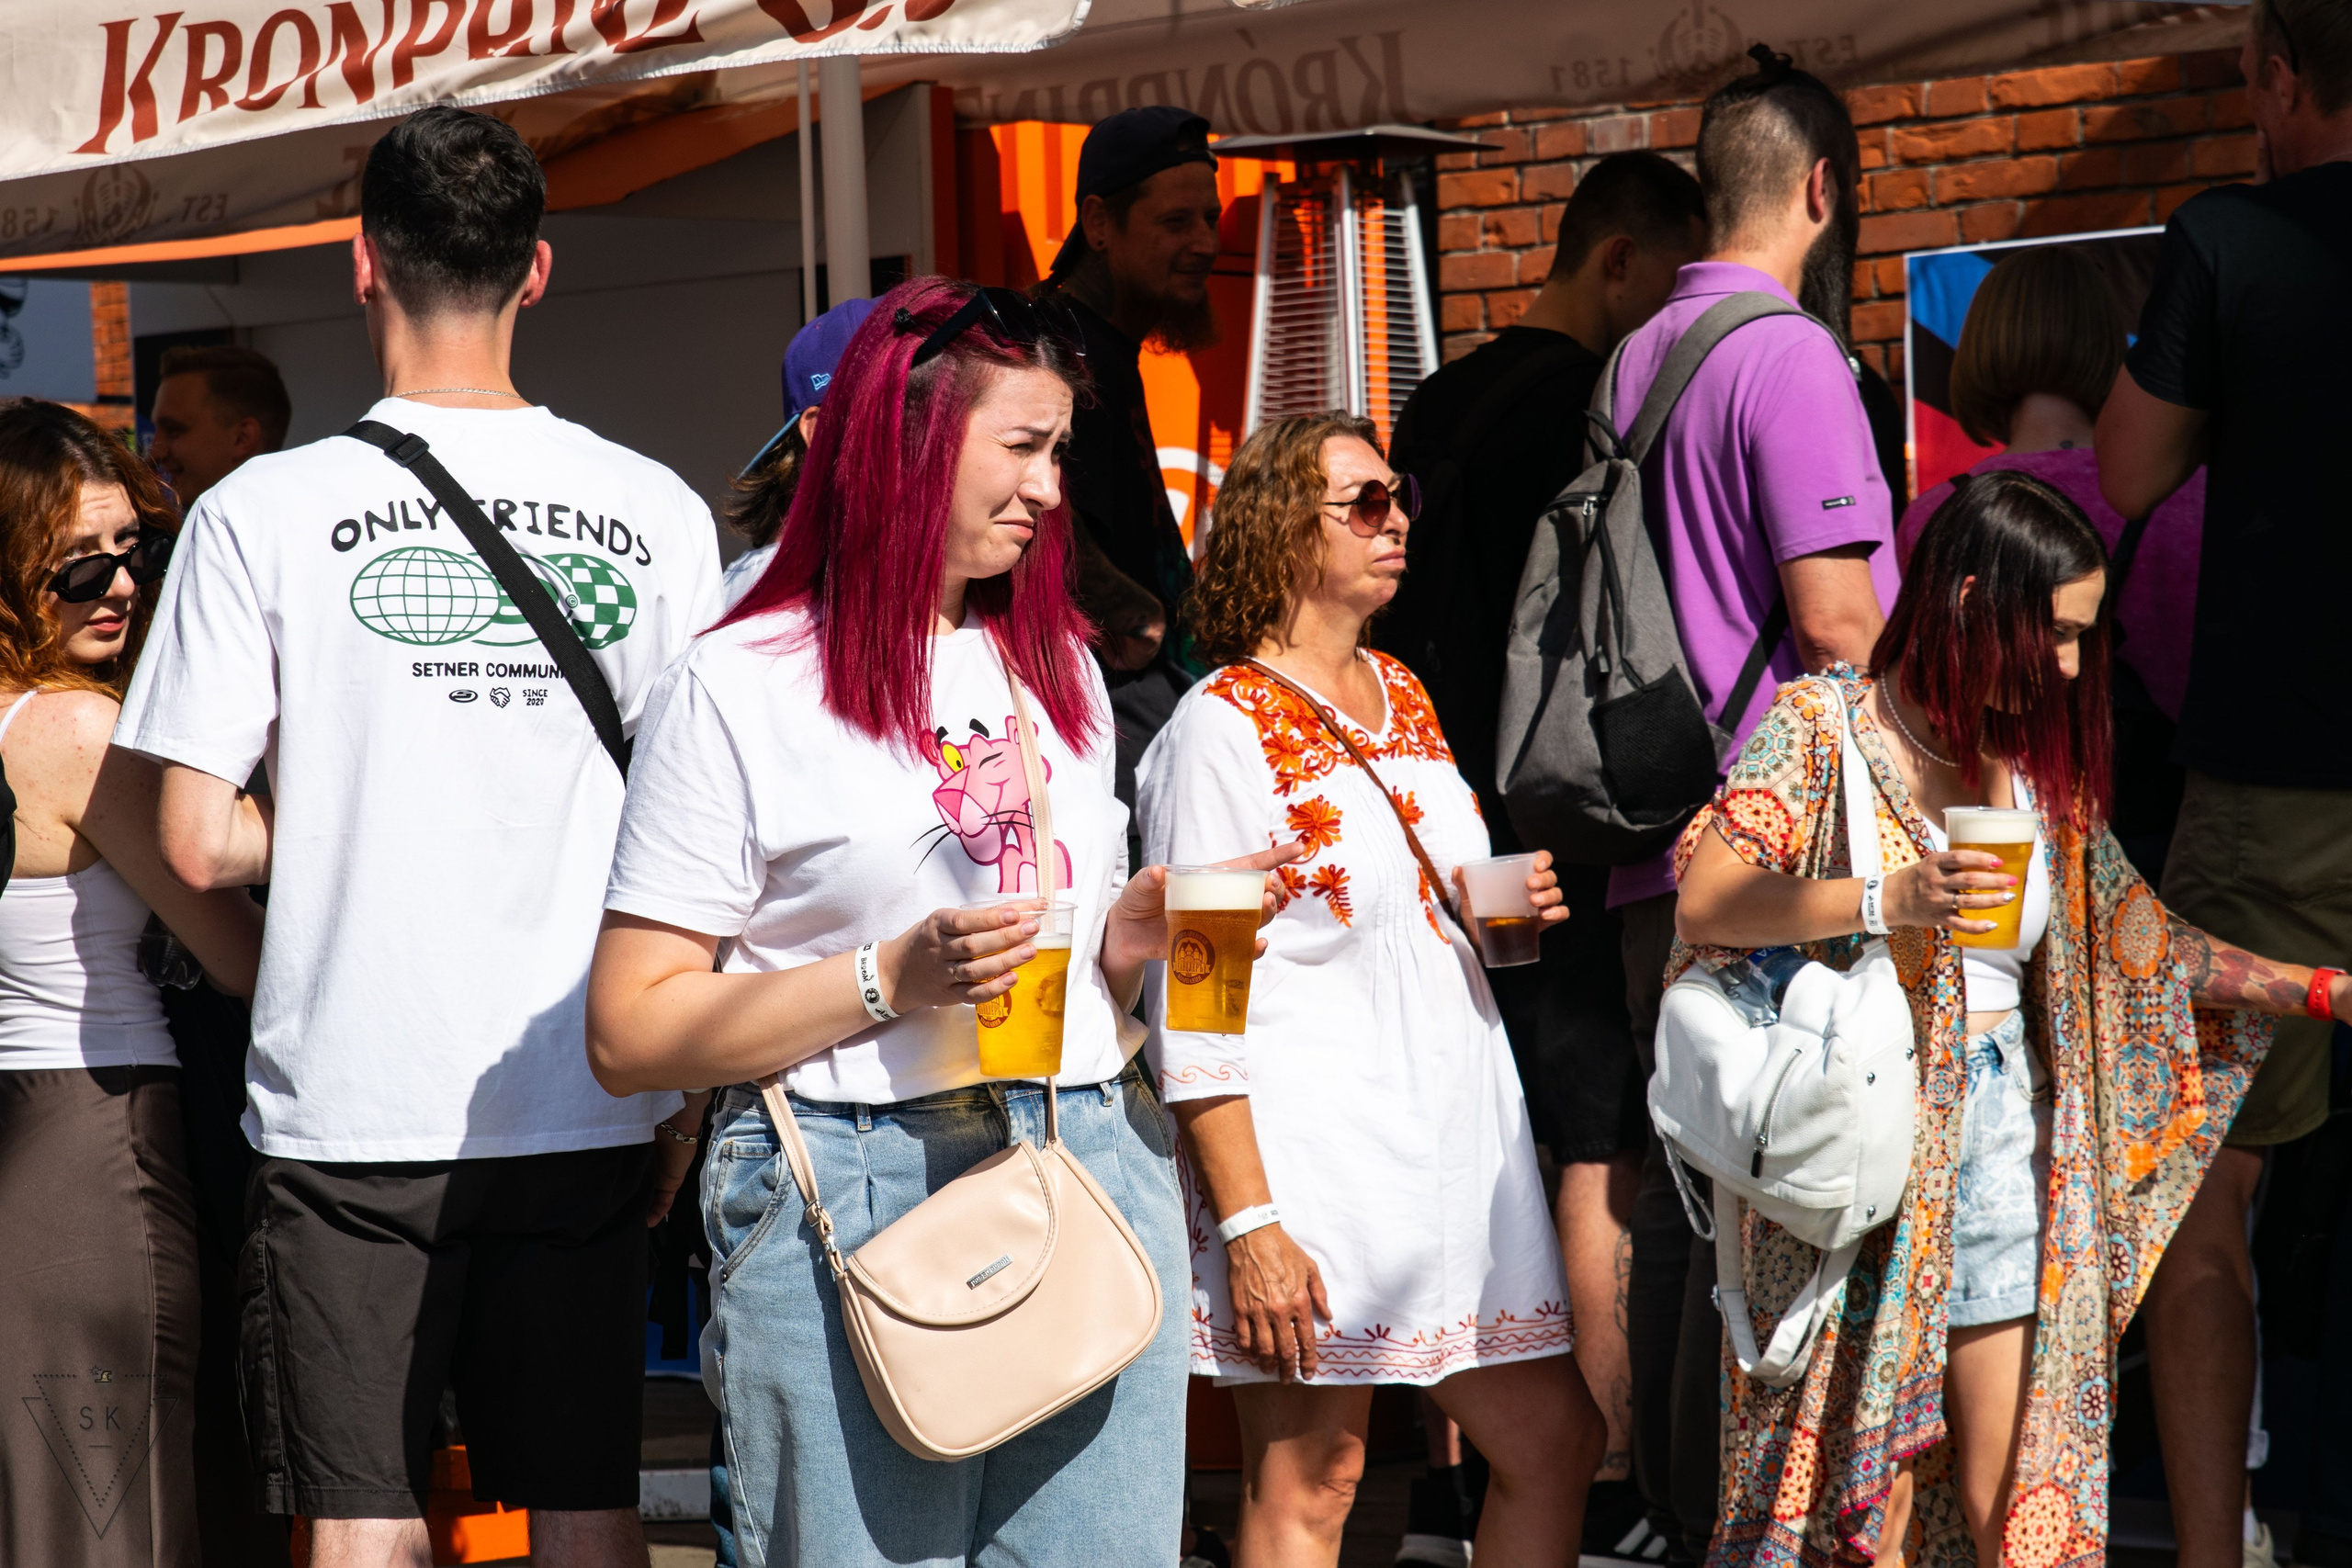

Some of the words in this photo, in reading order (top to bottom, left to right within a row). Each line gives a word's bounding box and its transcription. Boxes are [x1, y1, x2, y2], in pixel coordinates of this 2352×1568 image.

[331, 497, 443, 552] ONLY
[471, 498, 652, 567] RIENDS
[412, 662, 480, 678] SETNER
[522, 688, 548, 697] SINCE
[526, 697, 545, 706] 2020
